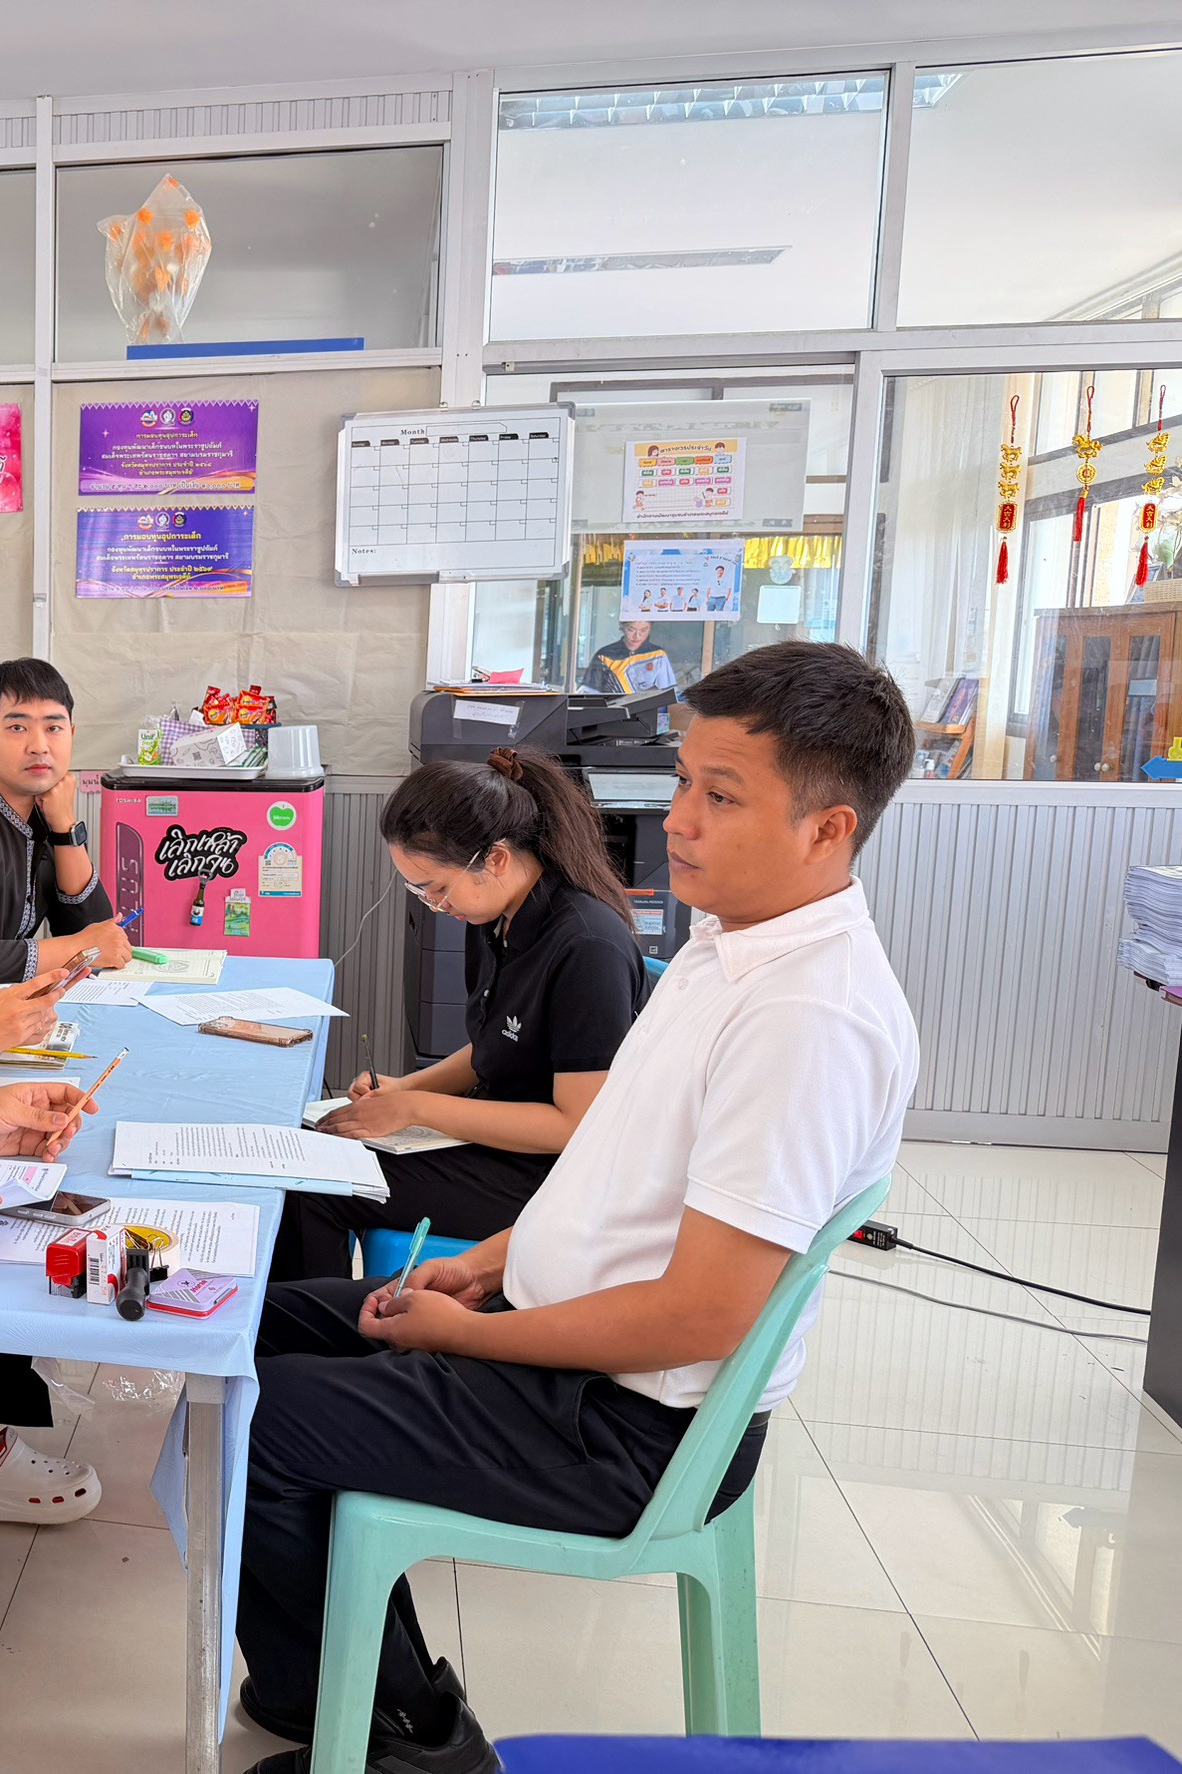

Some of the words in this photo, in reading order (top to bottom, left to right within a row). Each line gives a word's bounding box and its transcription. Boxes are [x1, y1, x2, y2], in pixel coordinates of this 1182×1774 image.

[400, 428, 425, 436] Month
[159, 828, 243, 860] เลิกเหล้า
[168, 853, 234, 877] เลิกจน
